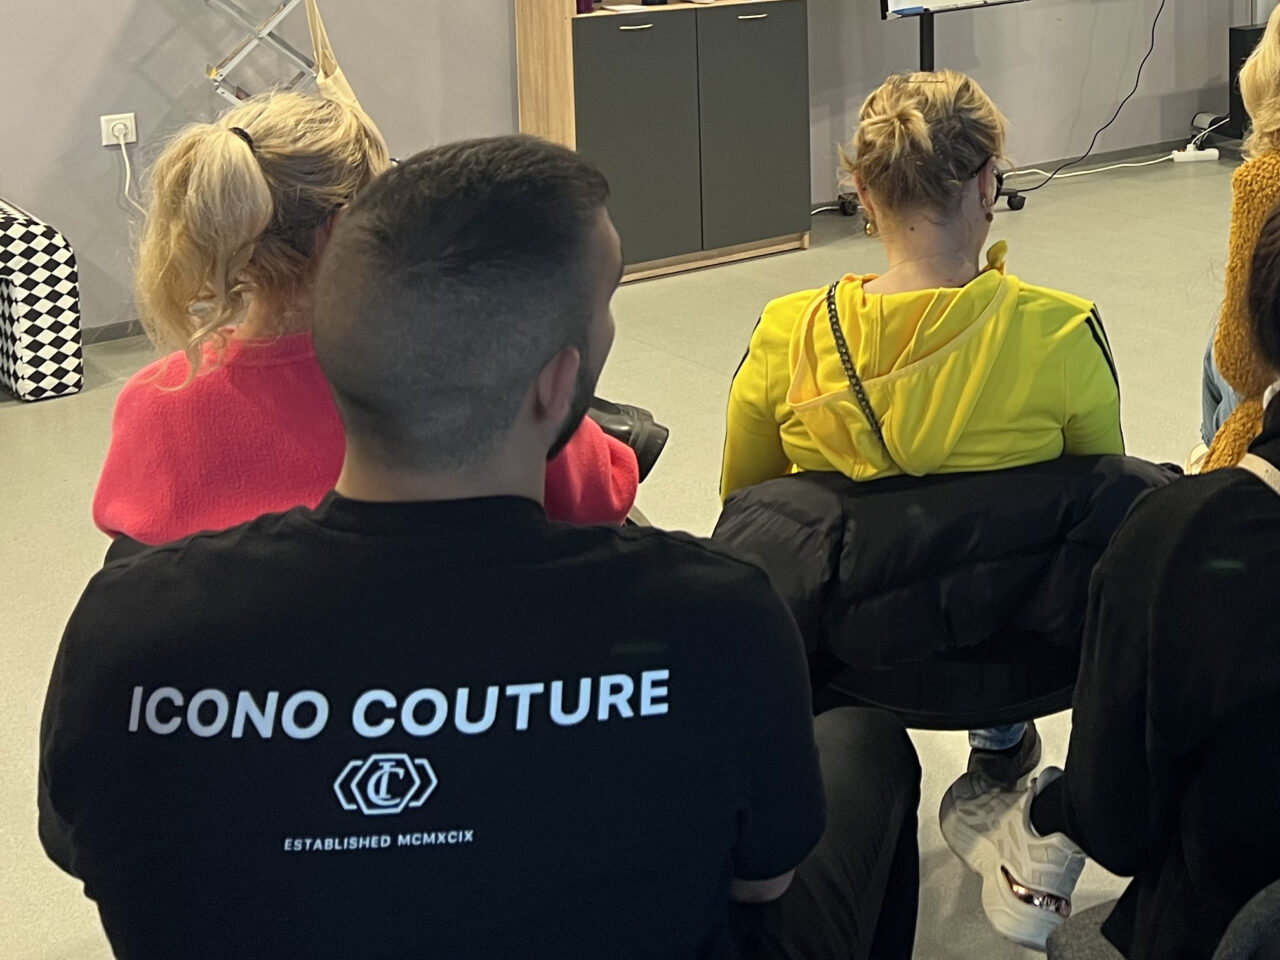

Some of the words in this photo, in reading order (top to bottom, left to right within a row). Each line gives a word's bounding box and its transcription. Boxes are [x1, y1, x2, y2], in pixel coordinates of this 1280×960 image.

[128, 685, 330, 740] ICONO
[351, 669, 670, 738] COUTURE
[283, 835, 391, 852] ESTABLISHED
[397, 829, 475, 847] MCMXCIX
